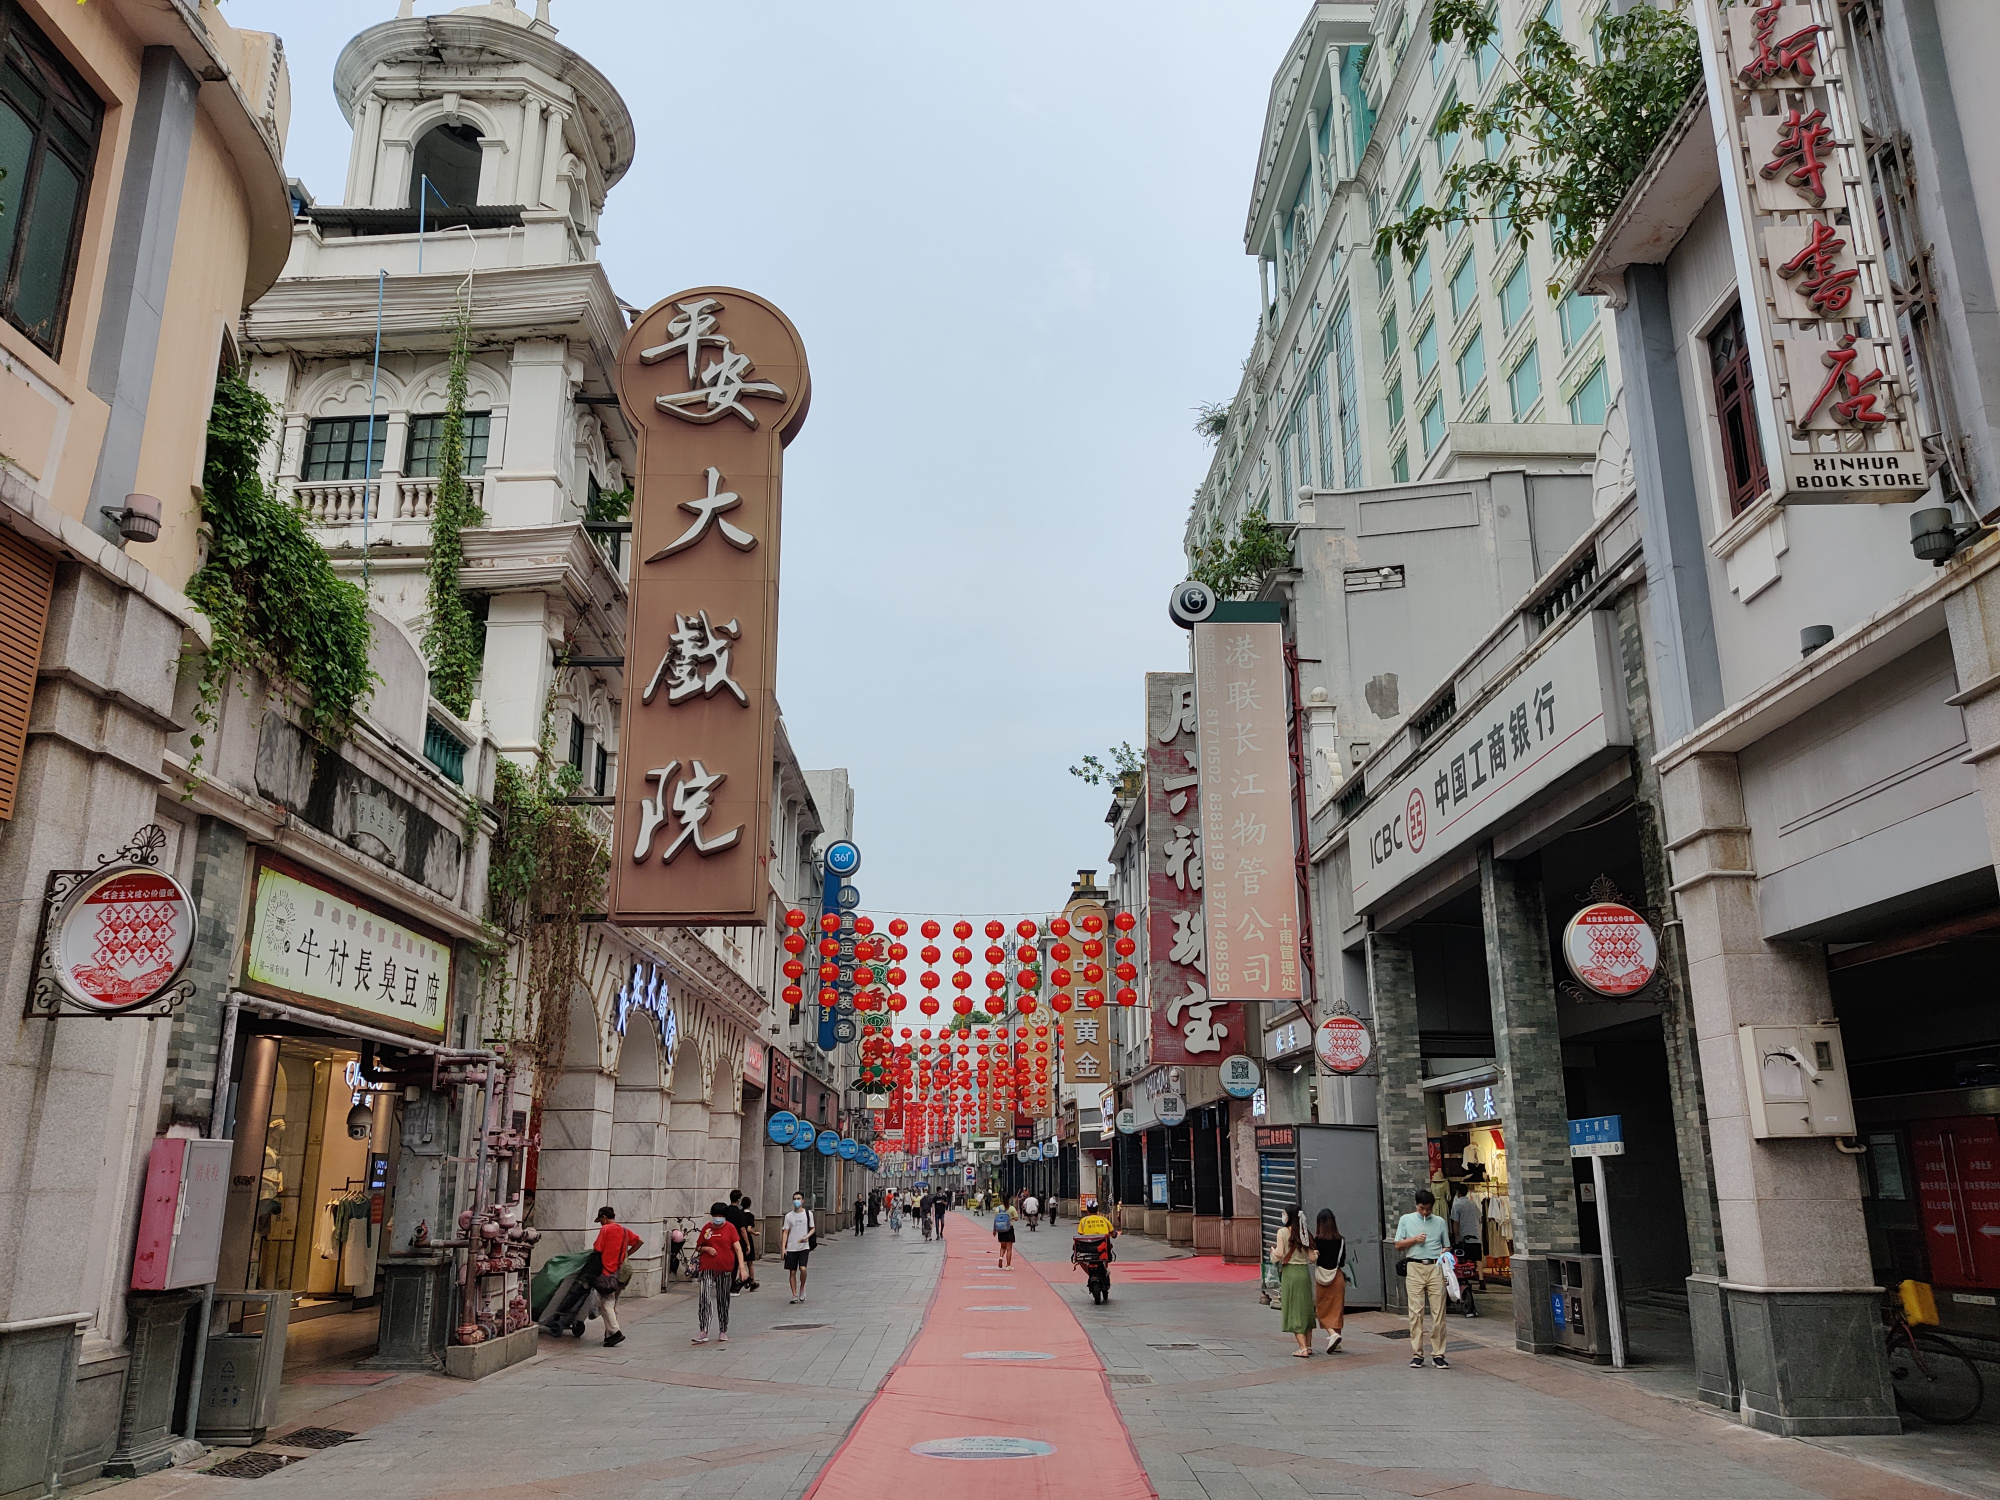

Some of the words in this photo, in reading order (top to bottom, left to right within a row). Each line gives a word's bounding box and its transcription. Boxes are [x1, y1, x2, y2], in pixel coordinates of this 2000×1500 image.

[1813, 456, 1900, 471] XINHUA
[1206, 708, 1222, 784] 81710502
[1434, 681, 1556, 816] 中国工商银行
[1208, 792, 1226, 871] 83833139
[1225, 635, 1274, 993] 港联长江物管公司
[1369, 814, 1403, 870] ICBC
[102, 888, 175, 900] 社会主义核心价值观
[296, 928, 440, 1017] 牛村長臭豆腐
[837, 889, 856, 1037] 儿童运动装备
[1212, 882, 1231, 992] 13711498595
[1278, 913, 1296, 992] 十甫管理处
